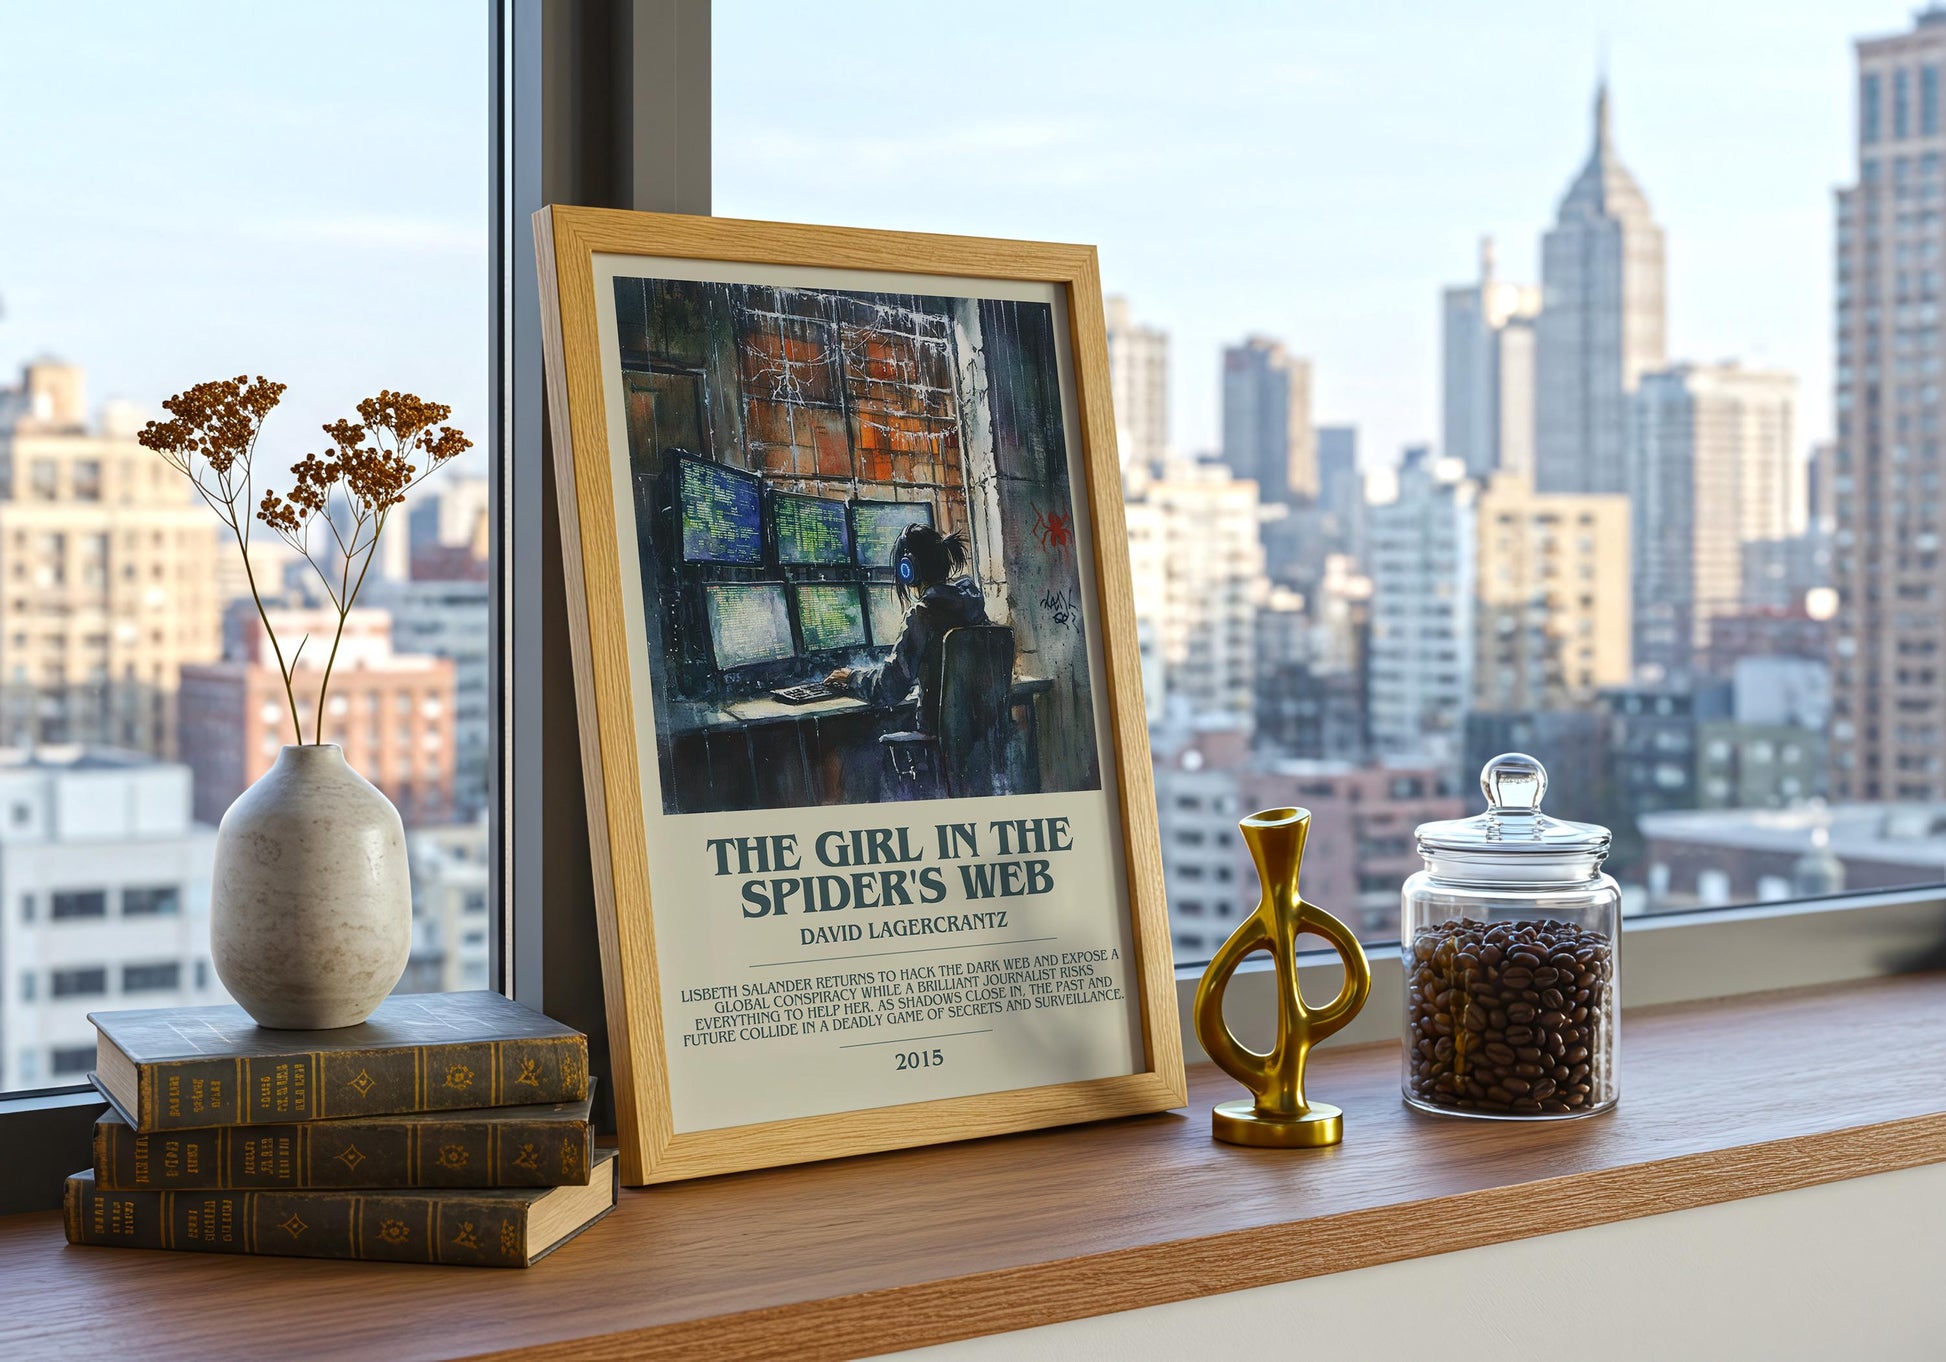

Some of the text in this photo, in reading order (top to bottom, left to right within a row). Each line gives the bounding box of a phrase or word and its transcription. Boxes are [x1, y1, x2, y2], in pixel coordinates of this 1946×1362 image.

[706, 816, 1074, 876] THE GIRL IN THE
[741, 859, 1054, 919] SPIDER'S WEB
[800, 911, 1008, 945] DAVID LAGERCRANTZ
[681, 948, 1119, 1003] LISBETH SALANDER RETURNS TO HACK THE DARK WEB AND EXPOSE A
[714, 964, 1094, 1014] GLOBAL CONSPIRACY WHILE A BRILLIANT JOURNALIST RISKS
[683, 988, 1125, 1047] FUTURE COLLIDE IN A DEADLY GAME OF SECRETS AND SURVEILLANCE.
[695, 976, 1112, 1031] EVERYTHING TO HELP HER. AS SHADOWS CLOSE IN, THE PAST AND
[895, 1049, 944, 1071] 2015
